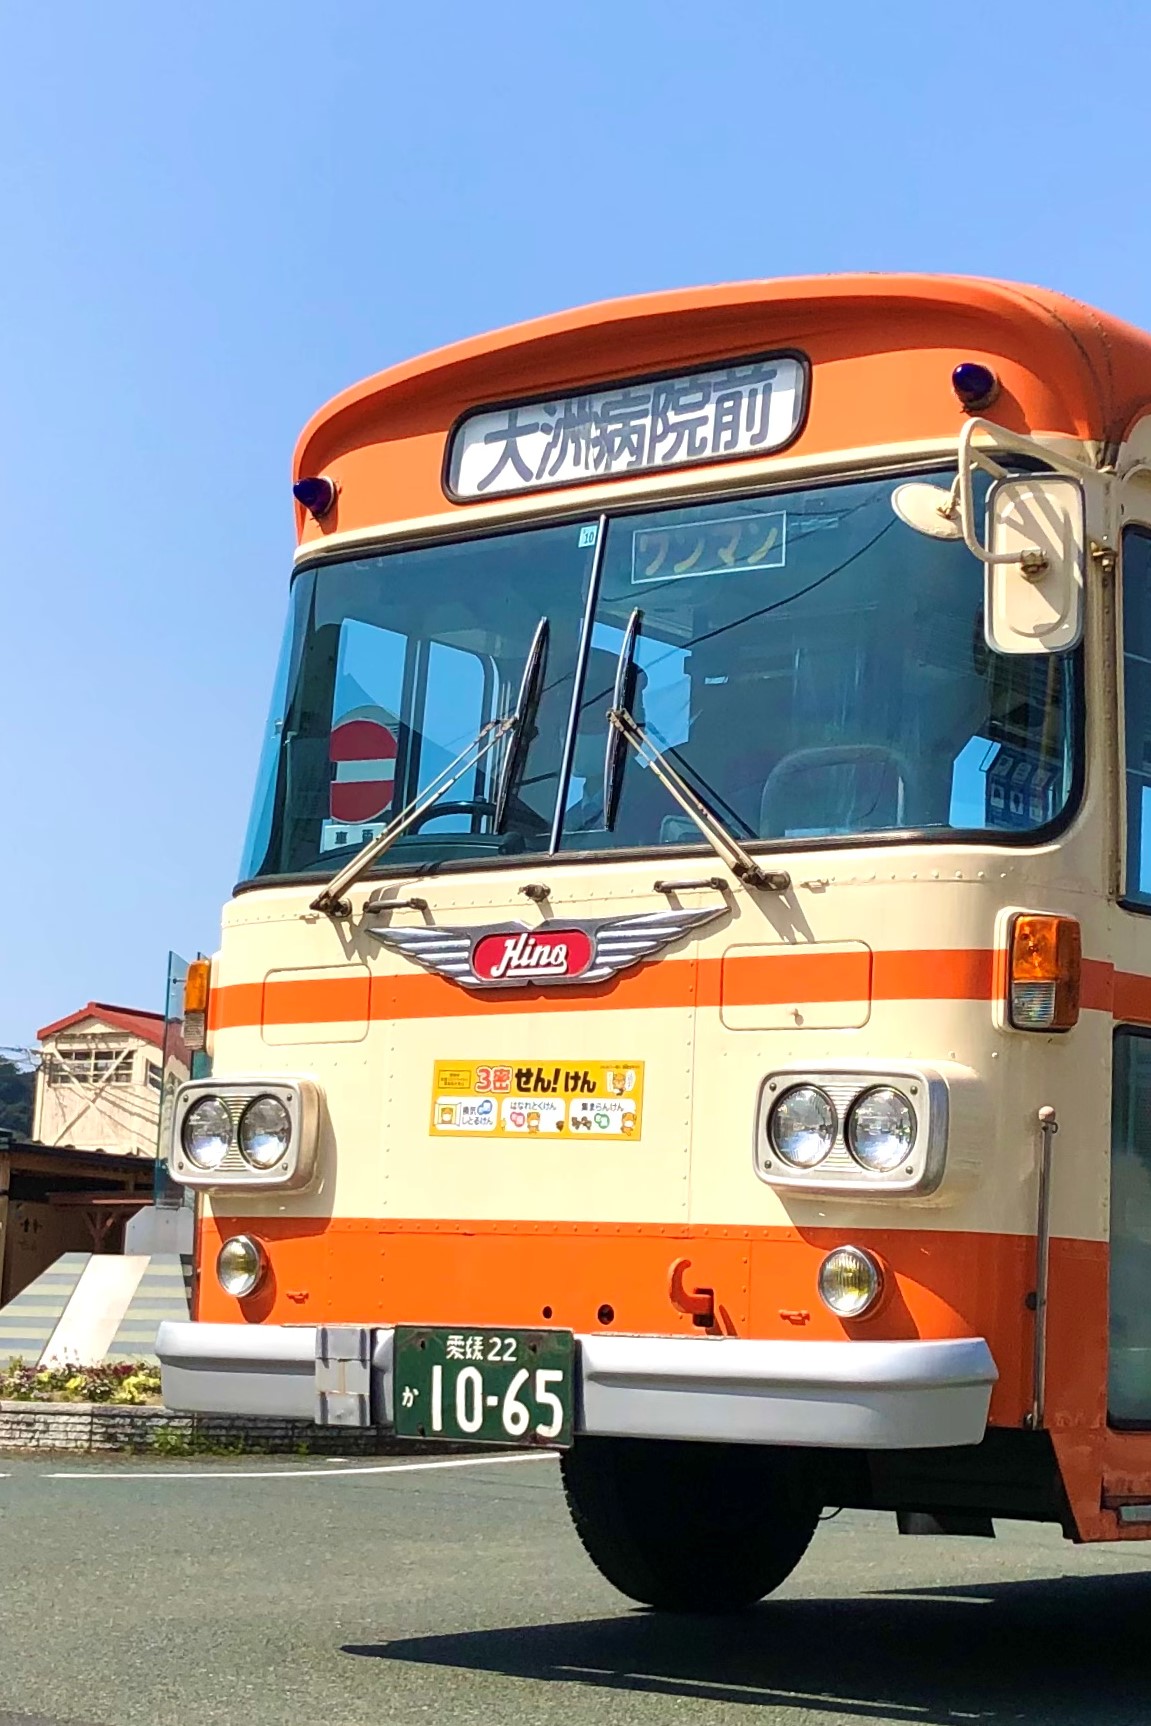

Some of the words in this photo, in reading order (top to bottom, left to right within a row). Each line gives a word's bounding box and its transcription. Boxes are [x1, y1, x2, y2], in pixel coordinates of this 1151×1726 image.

[477, 365, 778, 492] 大洲病院前
[490, 932, 568, 978] Hino
[402, 1386, 419, 1408] か
[431, 1364, 564, 1438] 10-65
